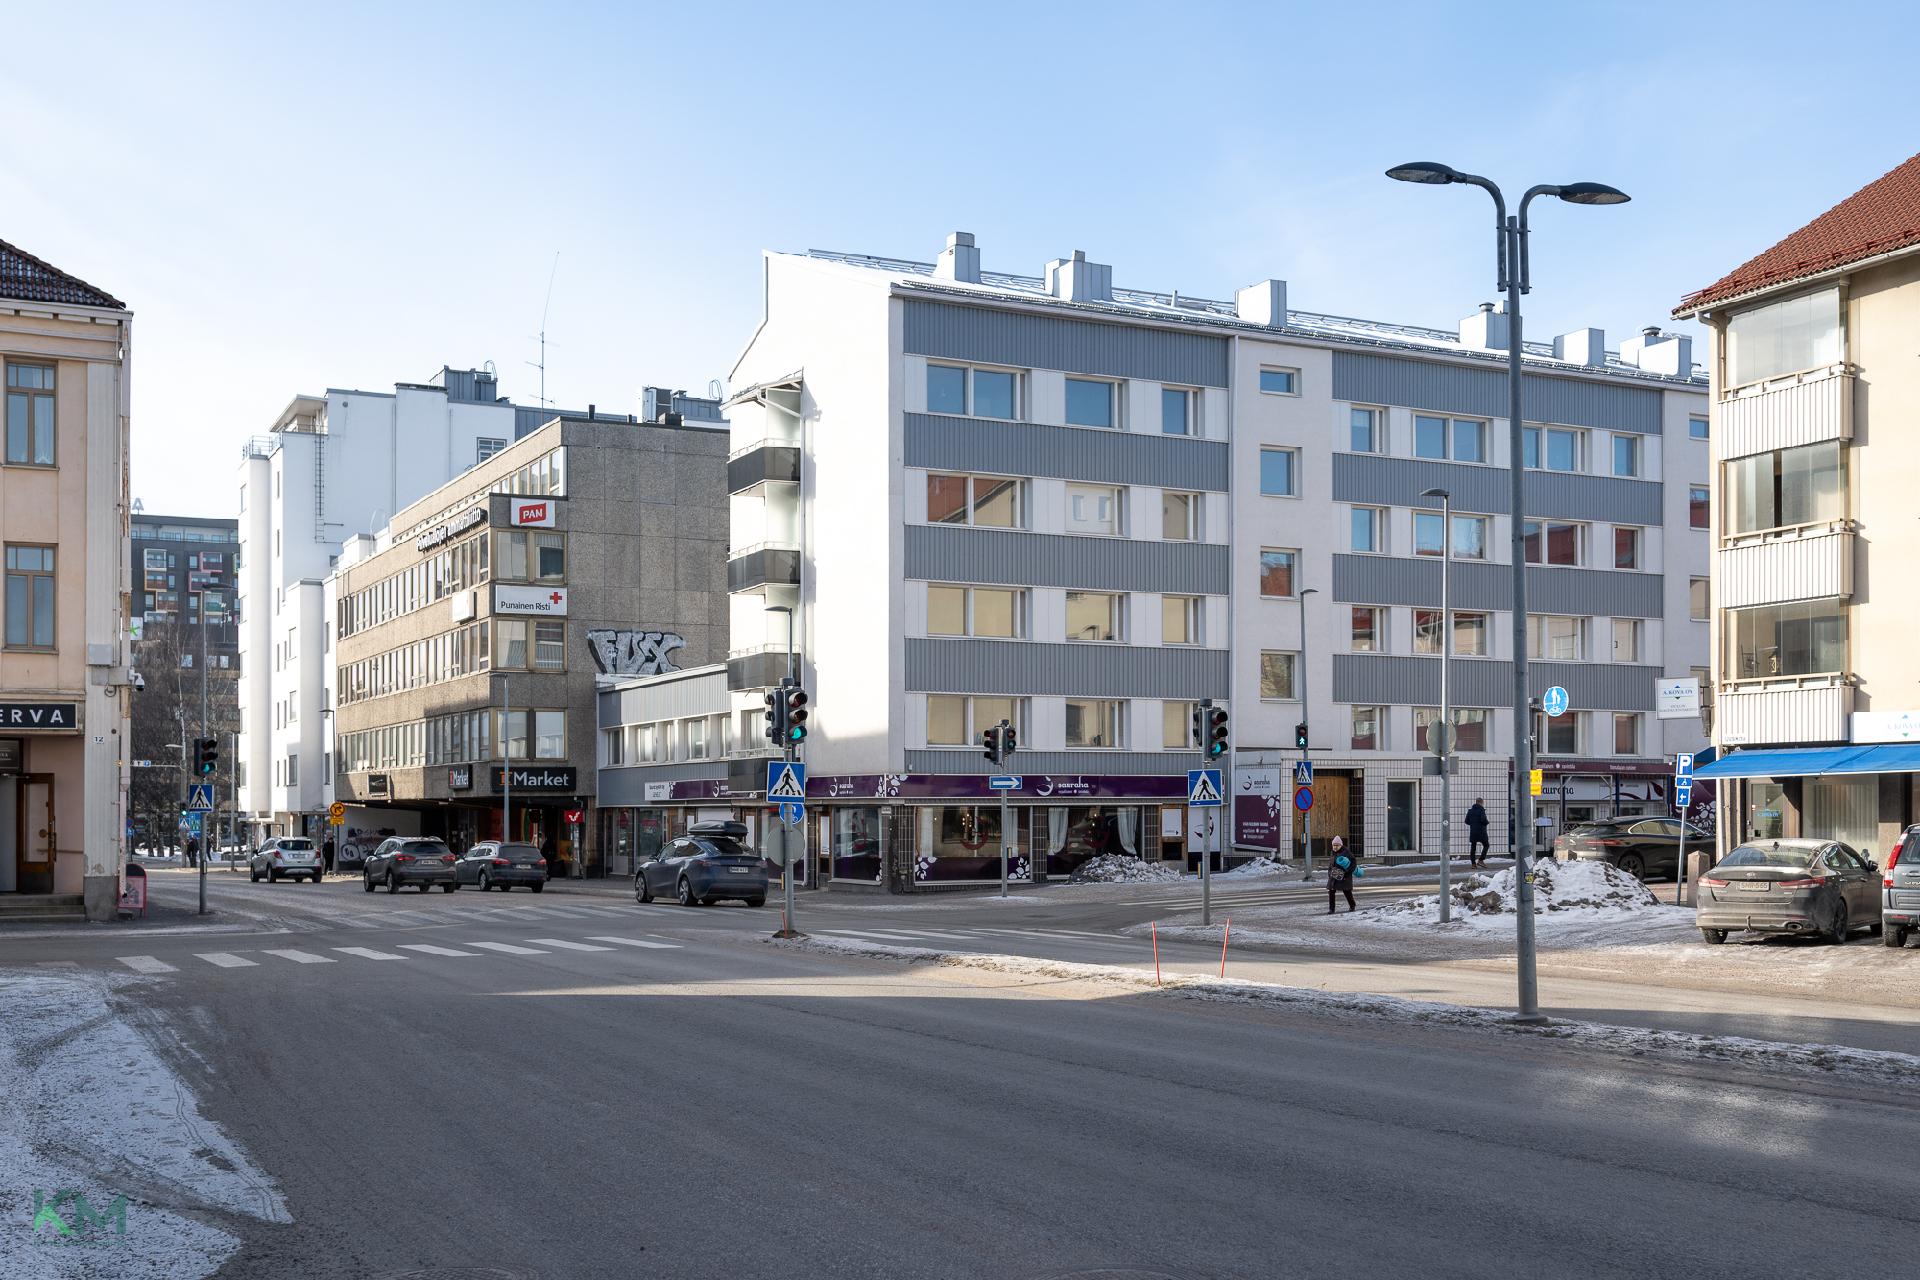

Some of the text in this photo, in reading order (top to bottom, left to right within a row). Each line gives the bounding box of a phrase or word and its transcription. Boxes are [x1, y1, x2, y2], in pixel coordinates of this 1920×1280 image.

[500, 601, 534, 610] Punainen
[1679, 755, 1691, 774] P
[513, 770, 569, 786] Market
